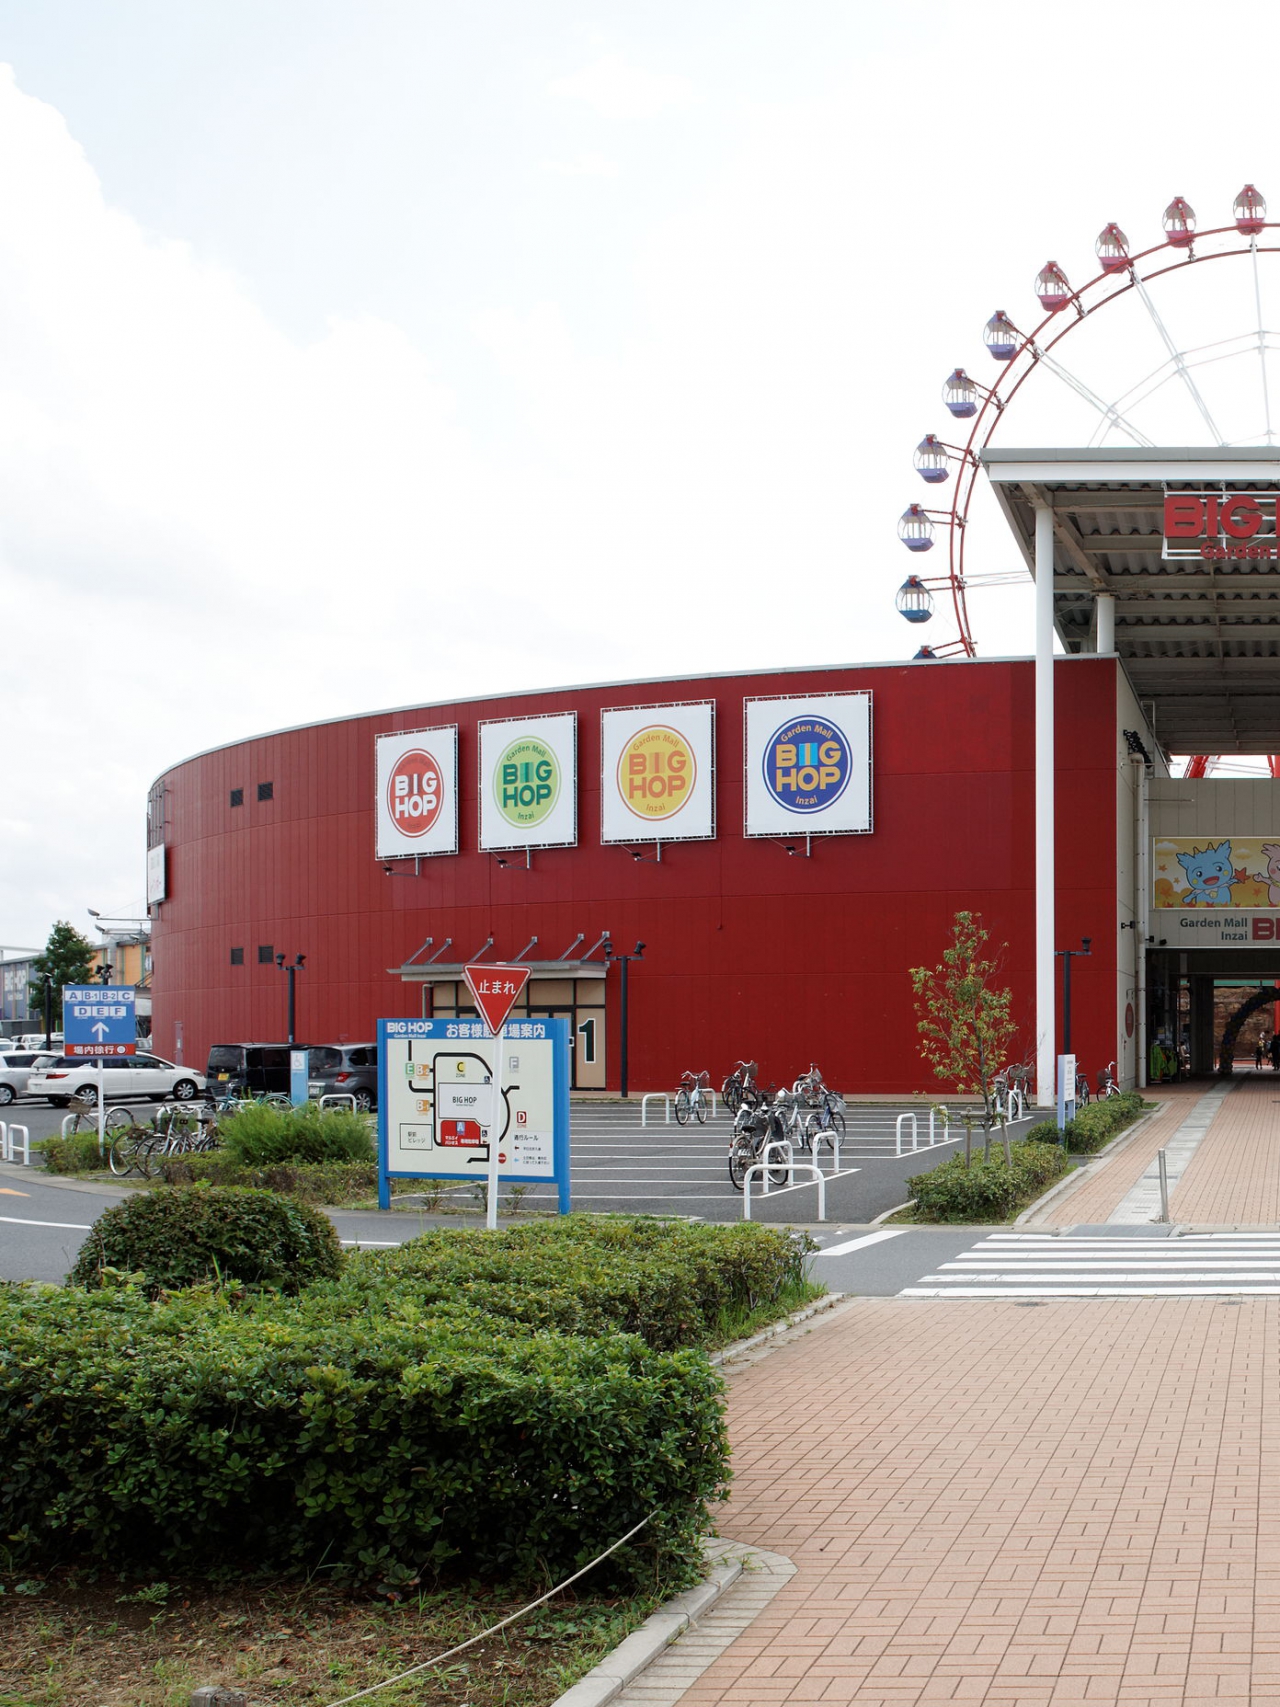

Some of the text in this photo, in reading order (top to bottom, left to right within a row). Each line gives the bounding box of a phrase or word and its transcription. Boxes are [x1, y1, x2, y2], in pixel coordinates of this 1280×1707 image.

[1164, 495, 1263, 538] BIG
[1200, 542, 1272, 560] Garden
[781, 724, 834, 742] Garden Mall
[633, 734, 680, 751] Garden Mall
[506, 744, 547, 762] Garden Mall
[776, 741, 842, 768] BIG
[629, 750, 687, 776] BIG
[503, 760, 553, 786] BIG
[776, 766, 841, 792] HOP
[395, 771, 438, 797] BIG
[629, 774, 686, 800] HOP
[503, 783, 552, 808] HOP
[795, 795, 818, 805] Inzai
[395, 794, 437, 819] HOP
[646, 803, 666, 812] Inzai
[517, 811, 535, 820] Inzai
[1180, 917, 1248, 928] Garden Mall
[1221, 930, 1248, 941] Inzai
[478, 979, 517, 995] 止まれ
[69, 992, 131, 1000] A B-1 B-2 C
[387, 1022, 433, 1033] BIG HOP
[578, 1018, 596, 1063] 1
[406, 1063, 414, 1075] E
[457, 1062, 465, 1073] C
[452, 1096, 477, 1104] BIG HOP
[518, 1112, 526, 1123] D
